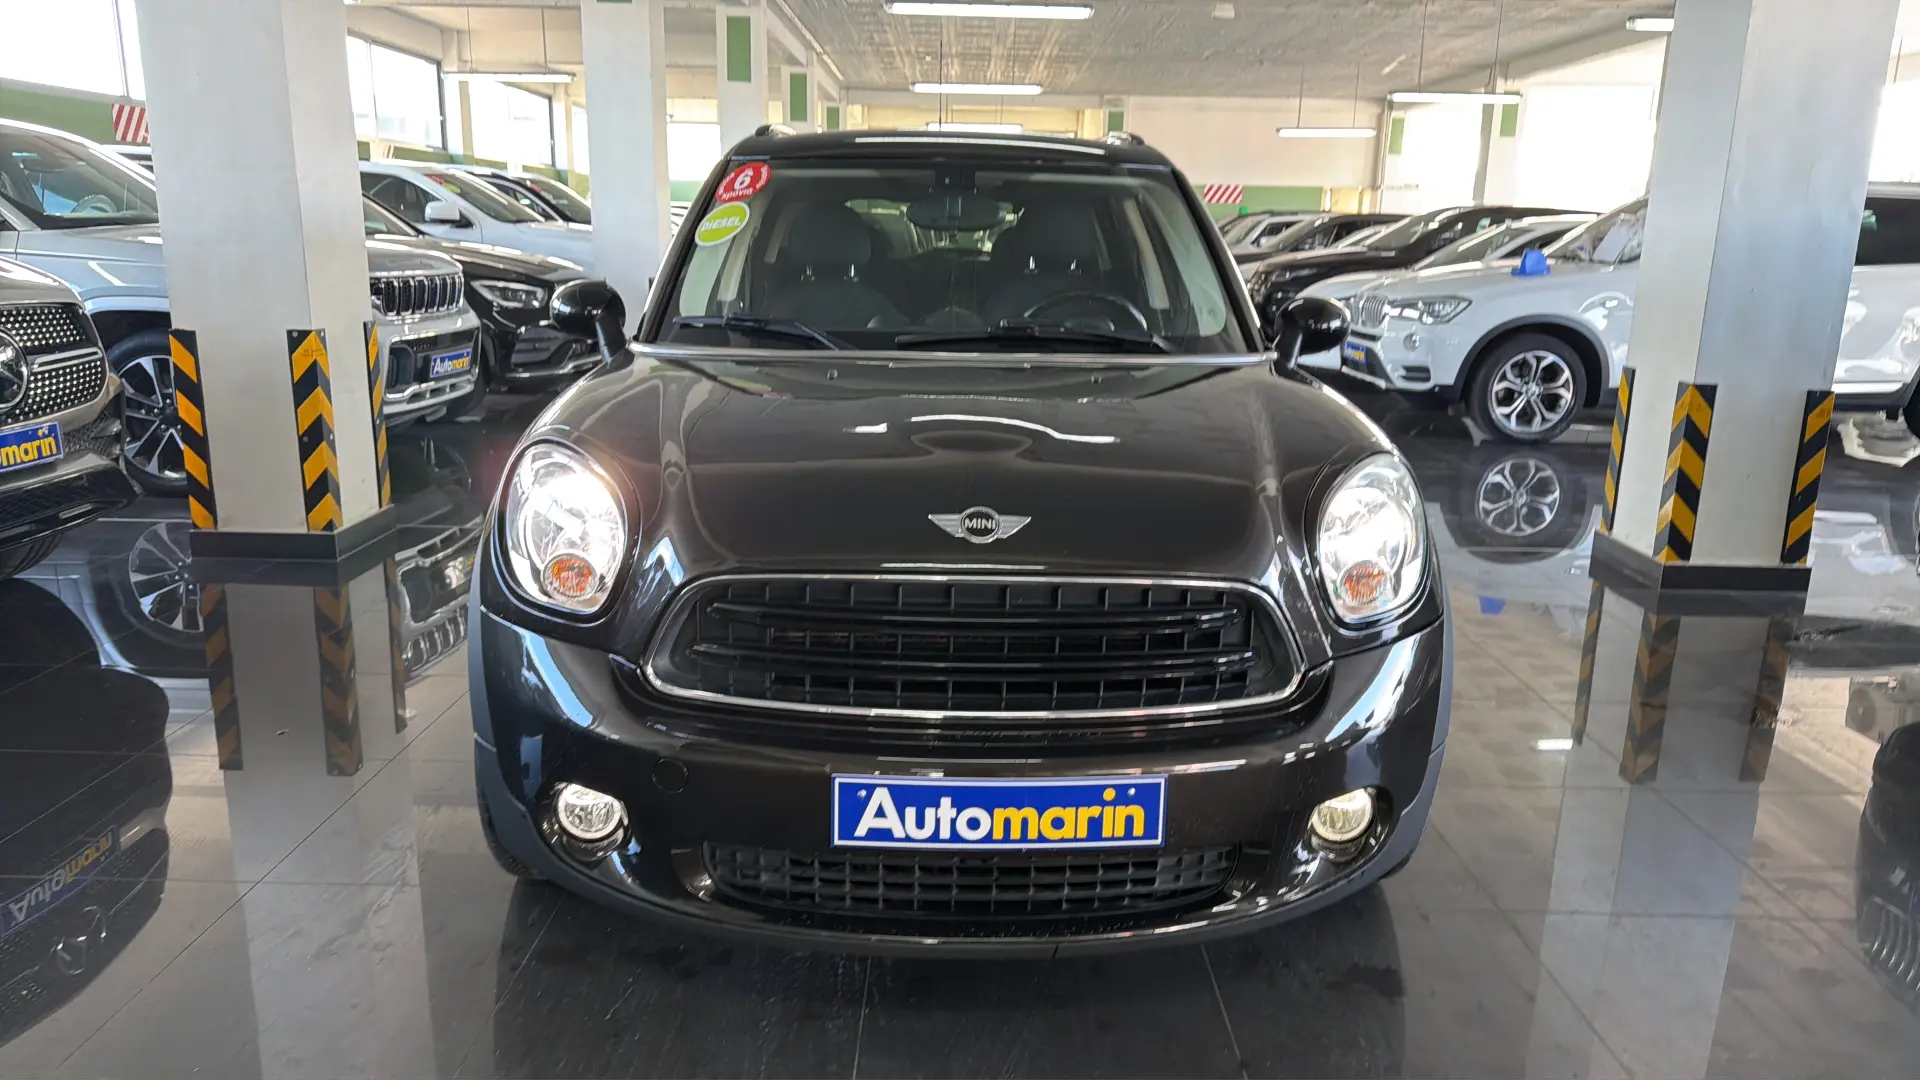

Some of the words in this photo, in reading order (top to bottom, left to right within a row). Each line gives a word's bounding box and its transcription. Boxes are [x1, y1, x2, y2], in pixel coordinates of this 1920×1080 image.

[734, 167, 754, 190] 6
[701, 215, 742, 232] DIESEL
[433, 356, 469, 375] Automarin
[0, 428, 57, 467] marin
[964, 518, 996, 530] MINI
[854, 786, 1145, 841] Automarin
